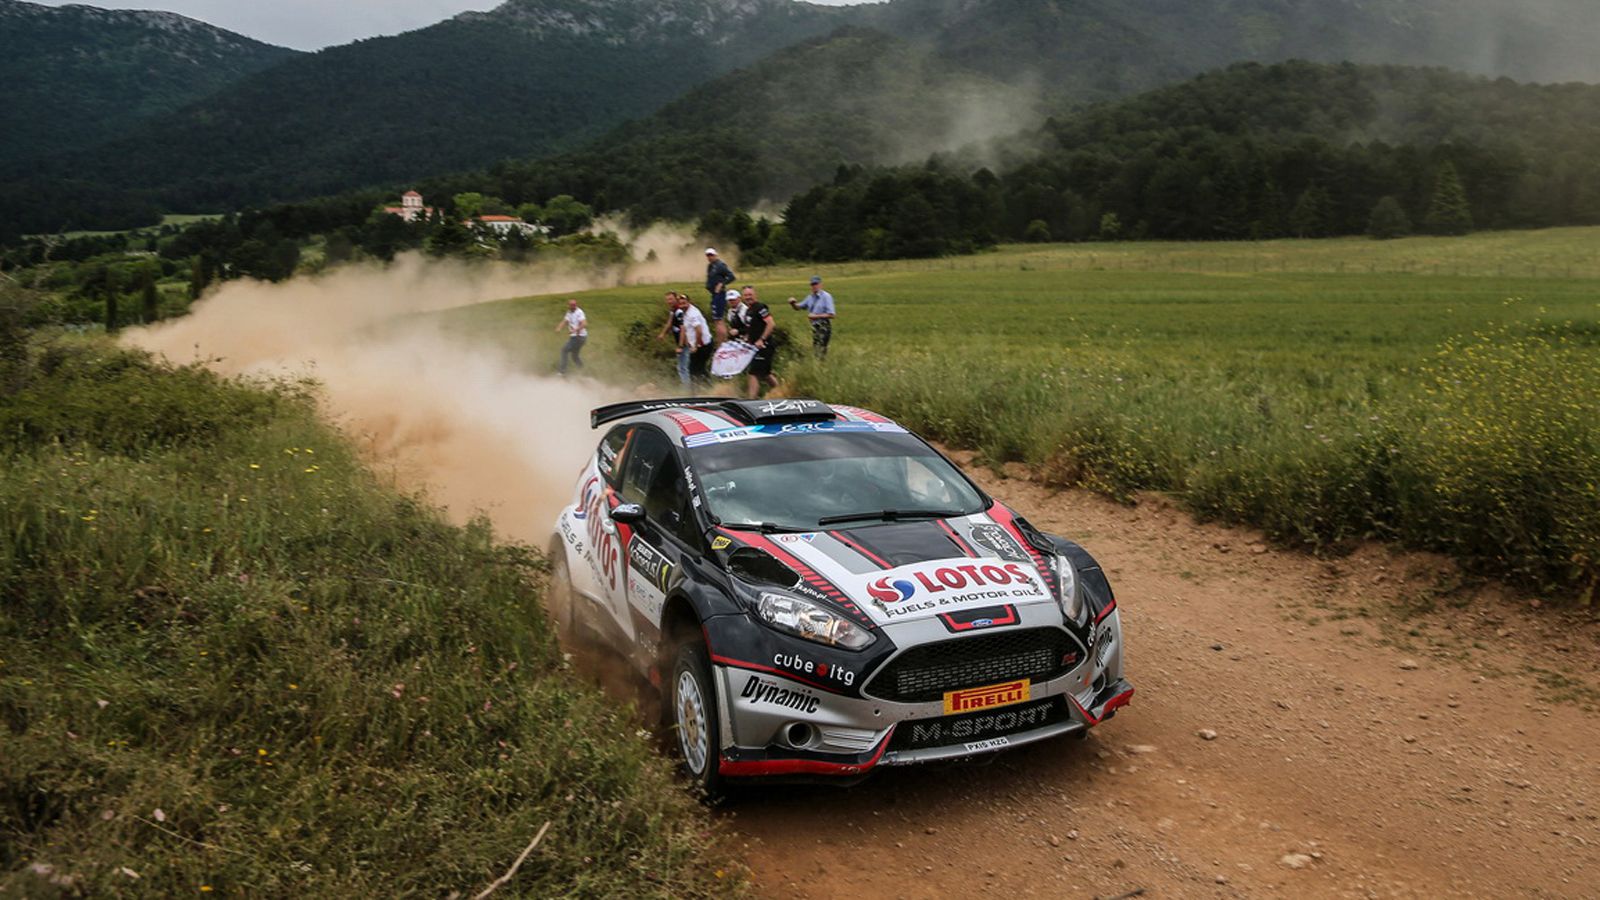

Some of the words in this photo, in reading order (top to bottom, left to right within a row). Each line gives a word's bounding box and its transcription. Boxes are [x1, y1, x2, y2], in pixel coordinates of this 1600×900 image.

[913, 563, 1030, 593] LOTOS
[886, 601, 936, 619] FUELS
[939, 598, 951, 606] &
[953, 590, 1010, 604] MOTOR
[773, 653, 814, 673] cube
[741, 675, 821, 714] Dynamic
[952, 682, 1024, 711] PIRELLI
